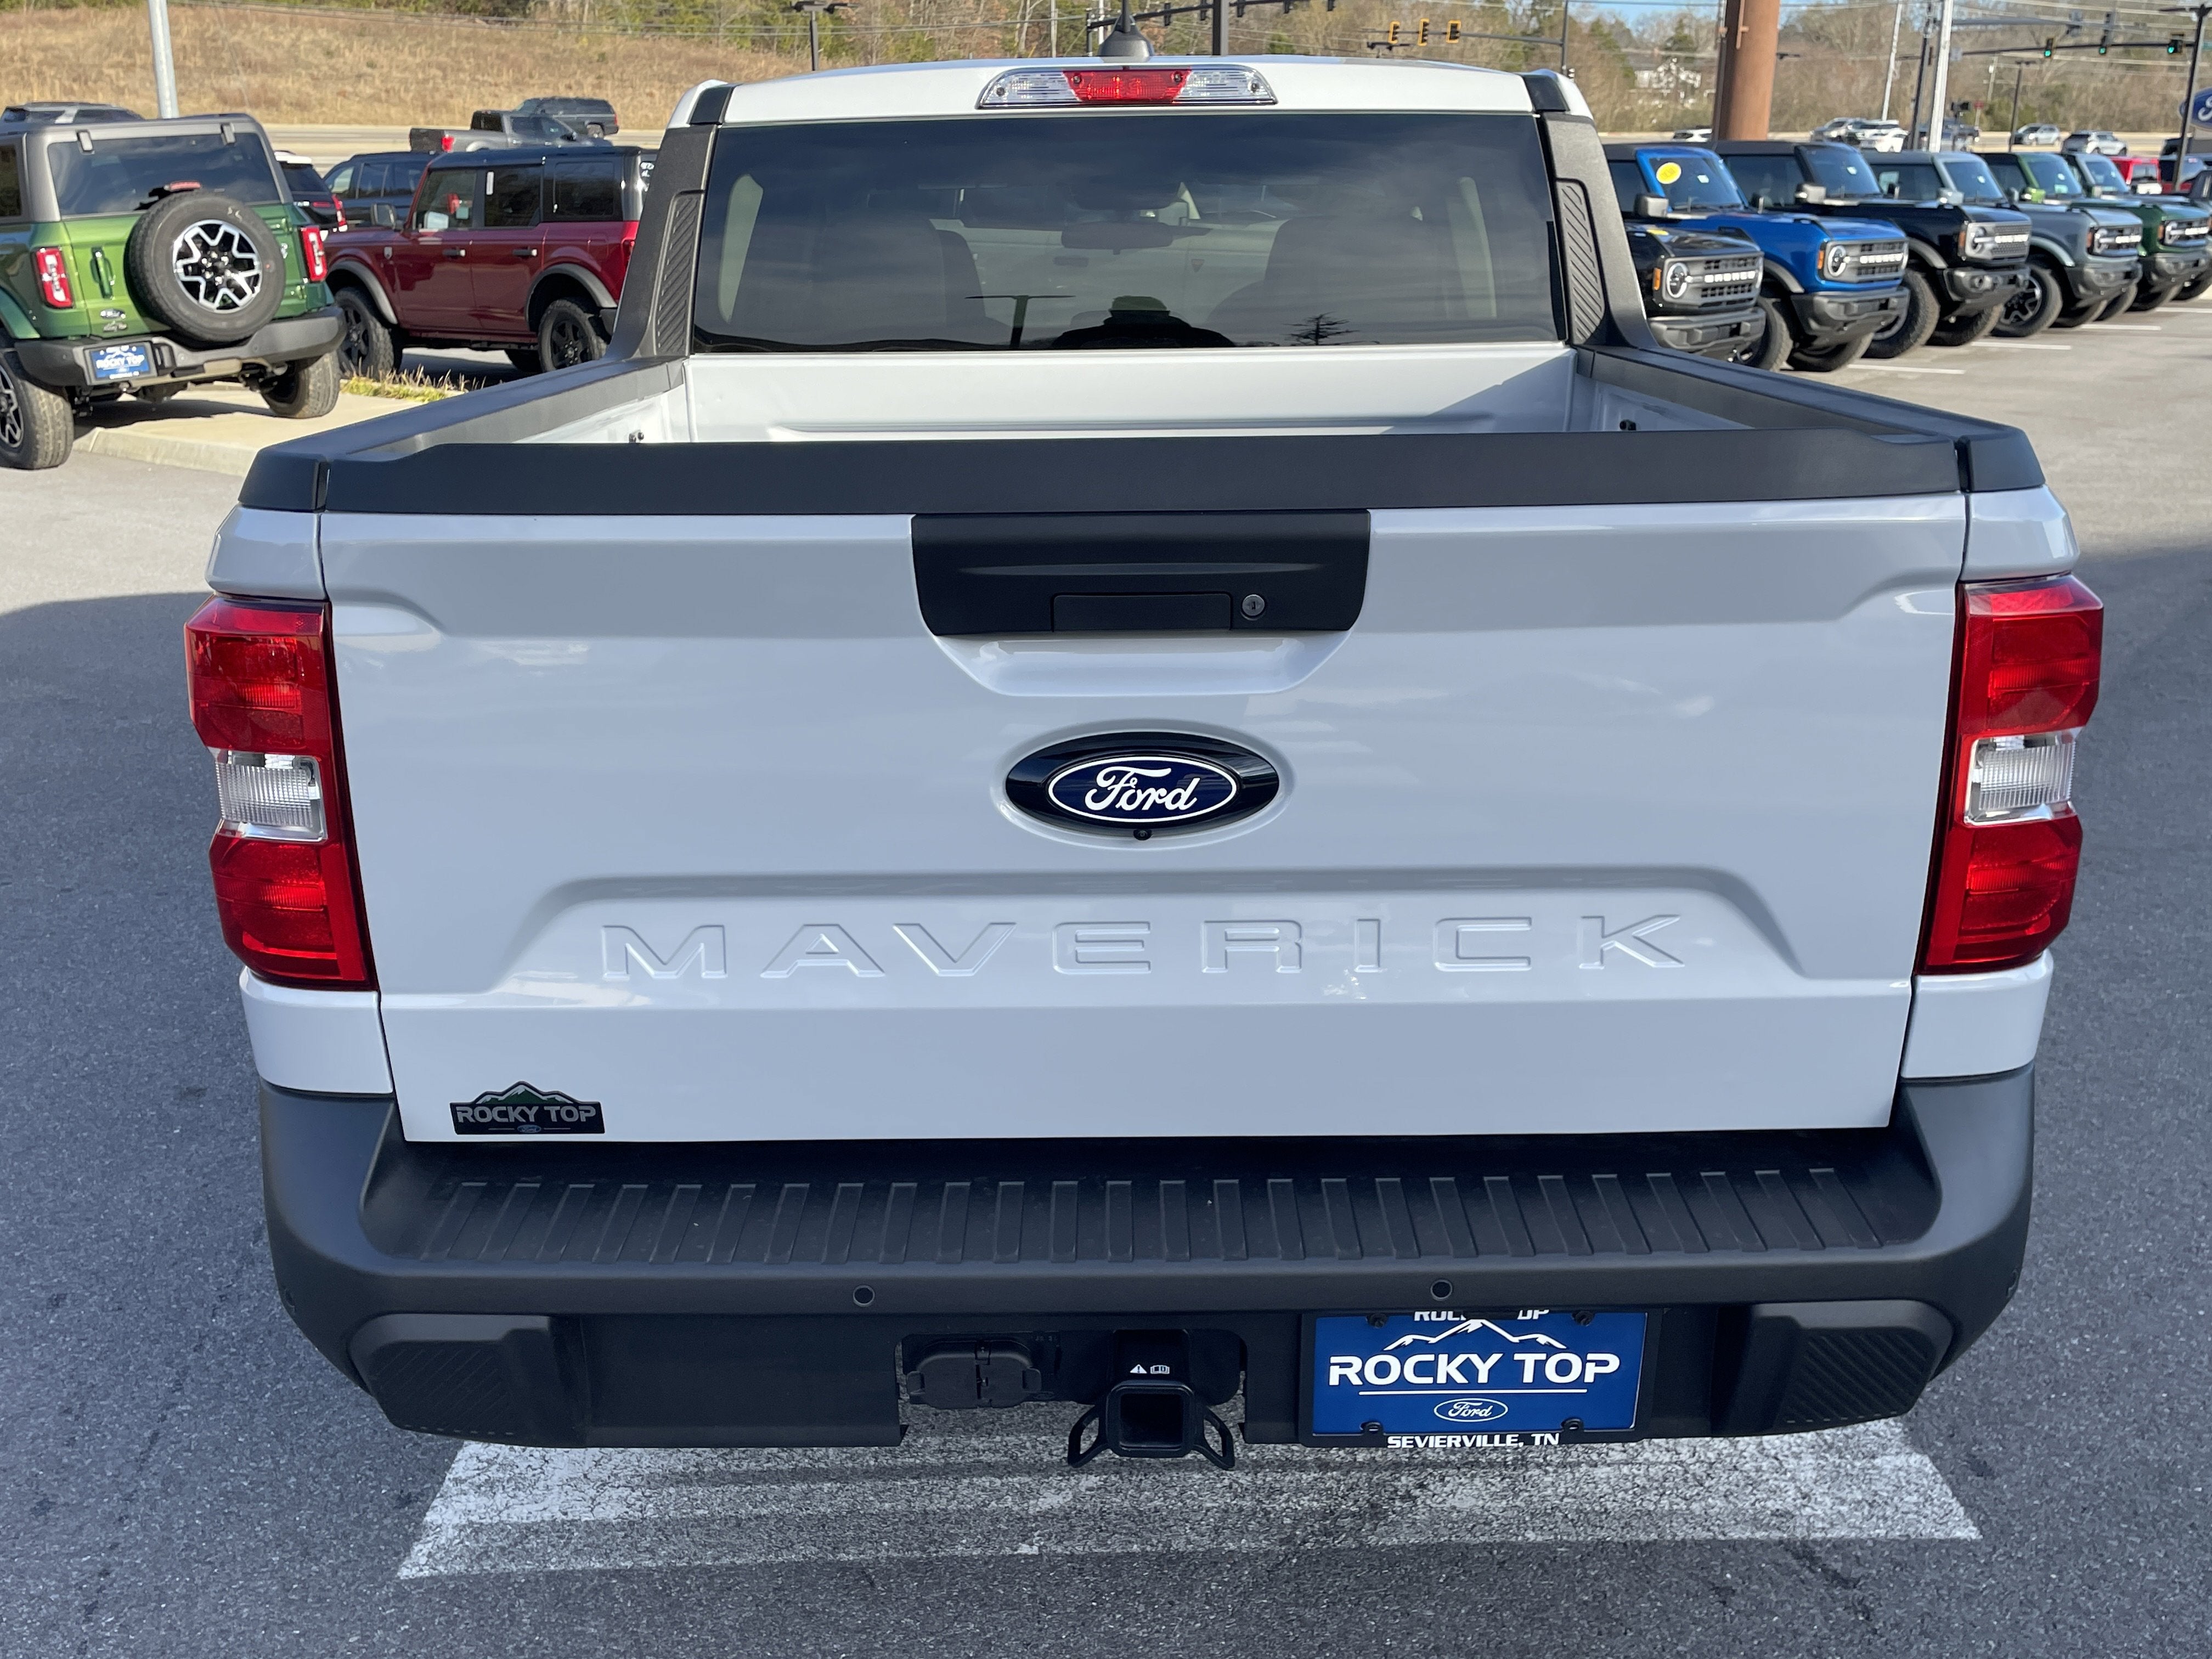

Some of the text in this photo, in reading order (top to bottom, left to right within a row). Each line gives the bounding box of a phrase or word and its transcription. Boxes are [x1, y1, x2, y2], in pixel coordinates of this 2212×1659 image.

[1084, 765, 1200, 811] Ford
[602, 914, 1685, 979] MAVERICK
[456, 1105, 596, 1123] ROCKY TOP
[1328, 1352, 1621, 1386] ROCKY TOP
[1448, 1401, 1493, 1417] Ford
[1387, 1432, 1559, 1448] SEVIERVILLE, TN
